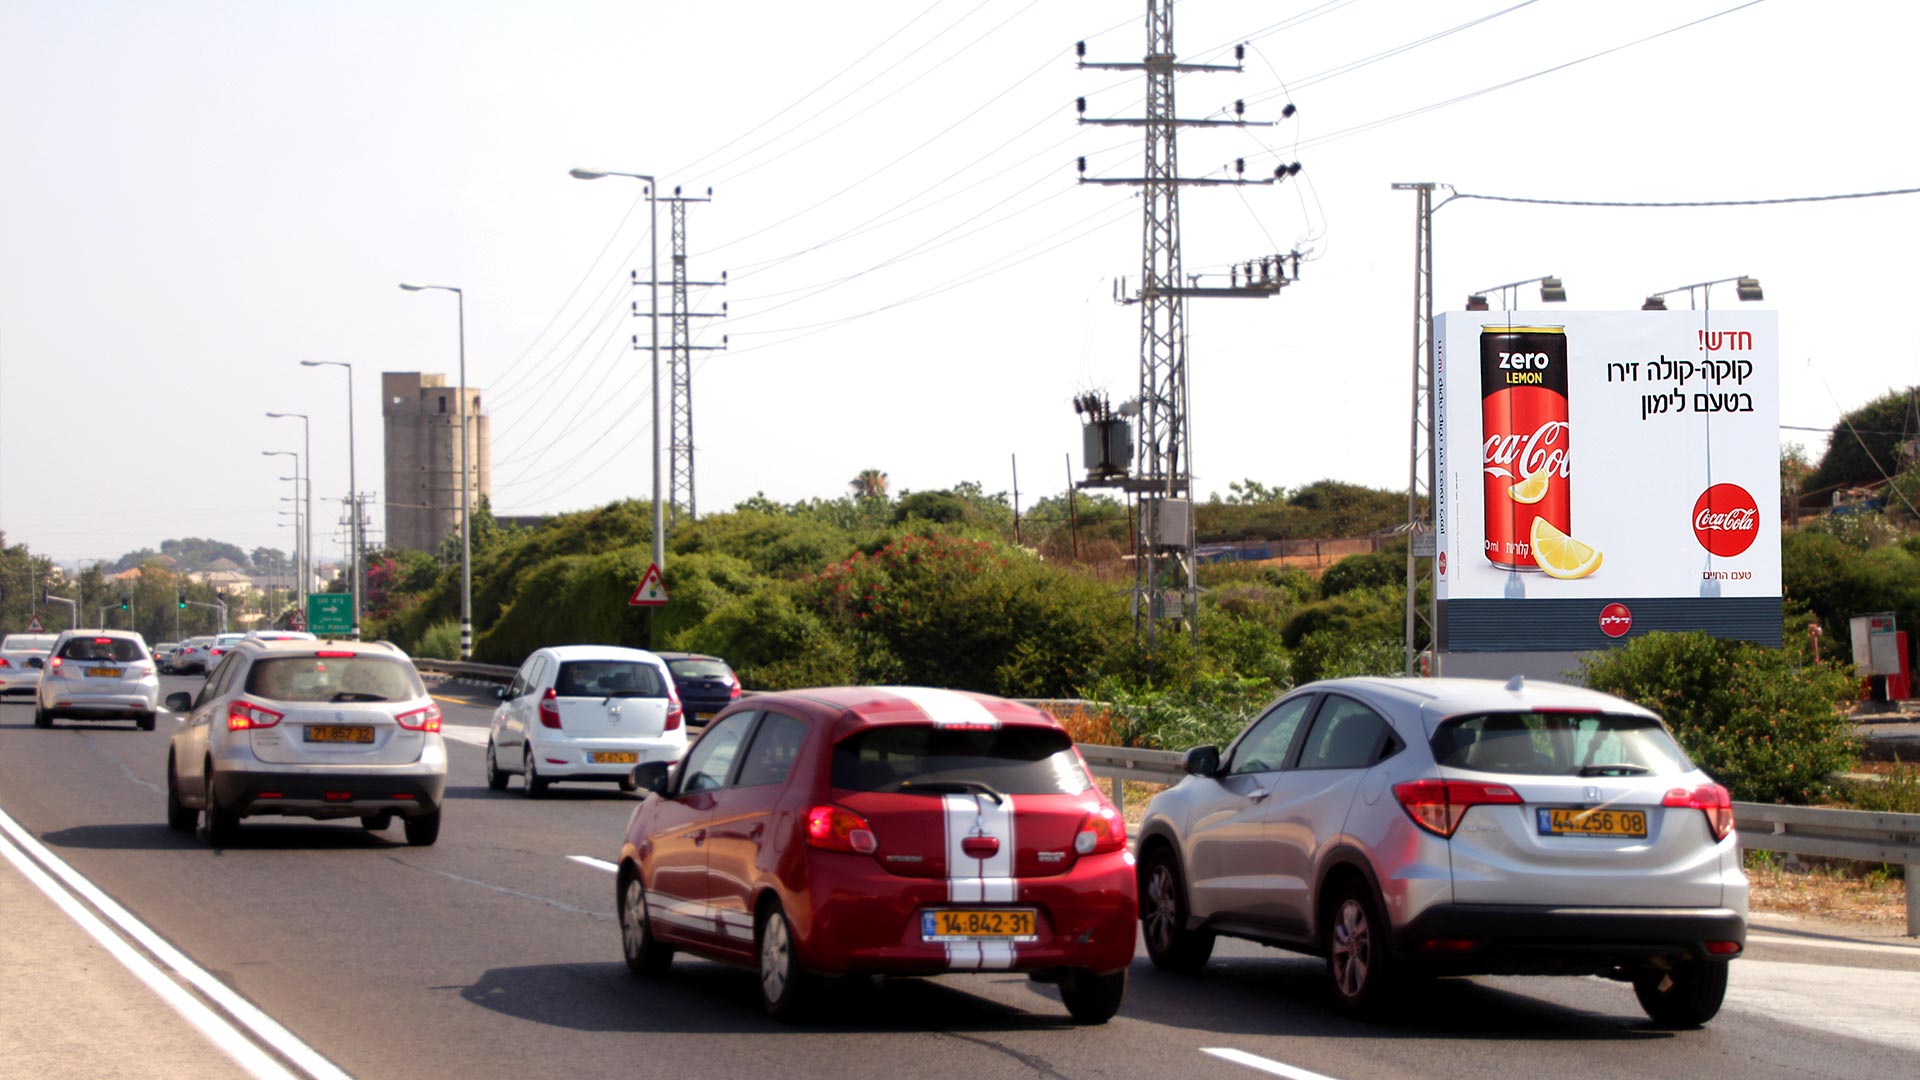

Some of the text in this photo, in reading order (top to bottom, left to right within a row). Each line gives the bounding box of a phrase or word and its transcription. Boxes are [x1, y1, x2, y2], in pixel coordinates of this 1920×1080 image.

[1698, 329, 1752, 351] חדש!
[1498, 352, 1550, 370] zero
[1607, 354, 1753, 386] קוקה-קולה זירו
[1506, 372, 1543, 384] LEMON
[1641, 387, 1754, 421] בטעם לימון
[1695, 507, 1757, 531] Coca-Cola
[1730, 571, 1752, 580] טעם
[1601, 615, 1630, 626] דלק
